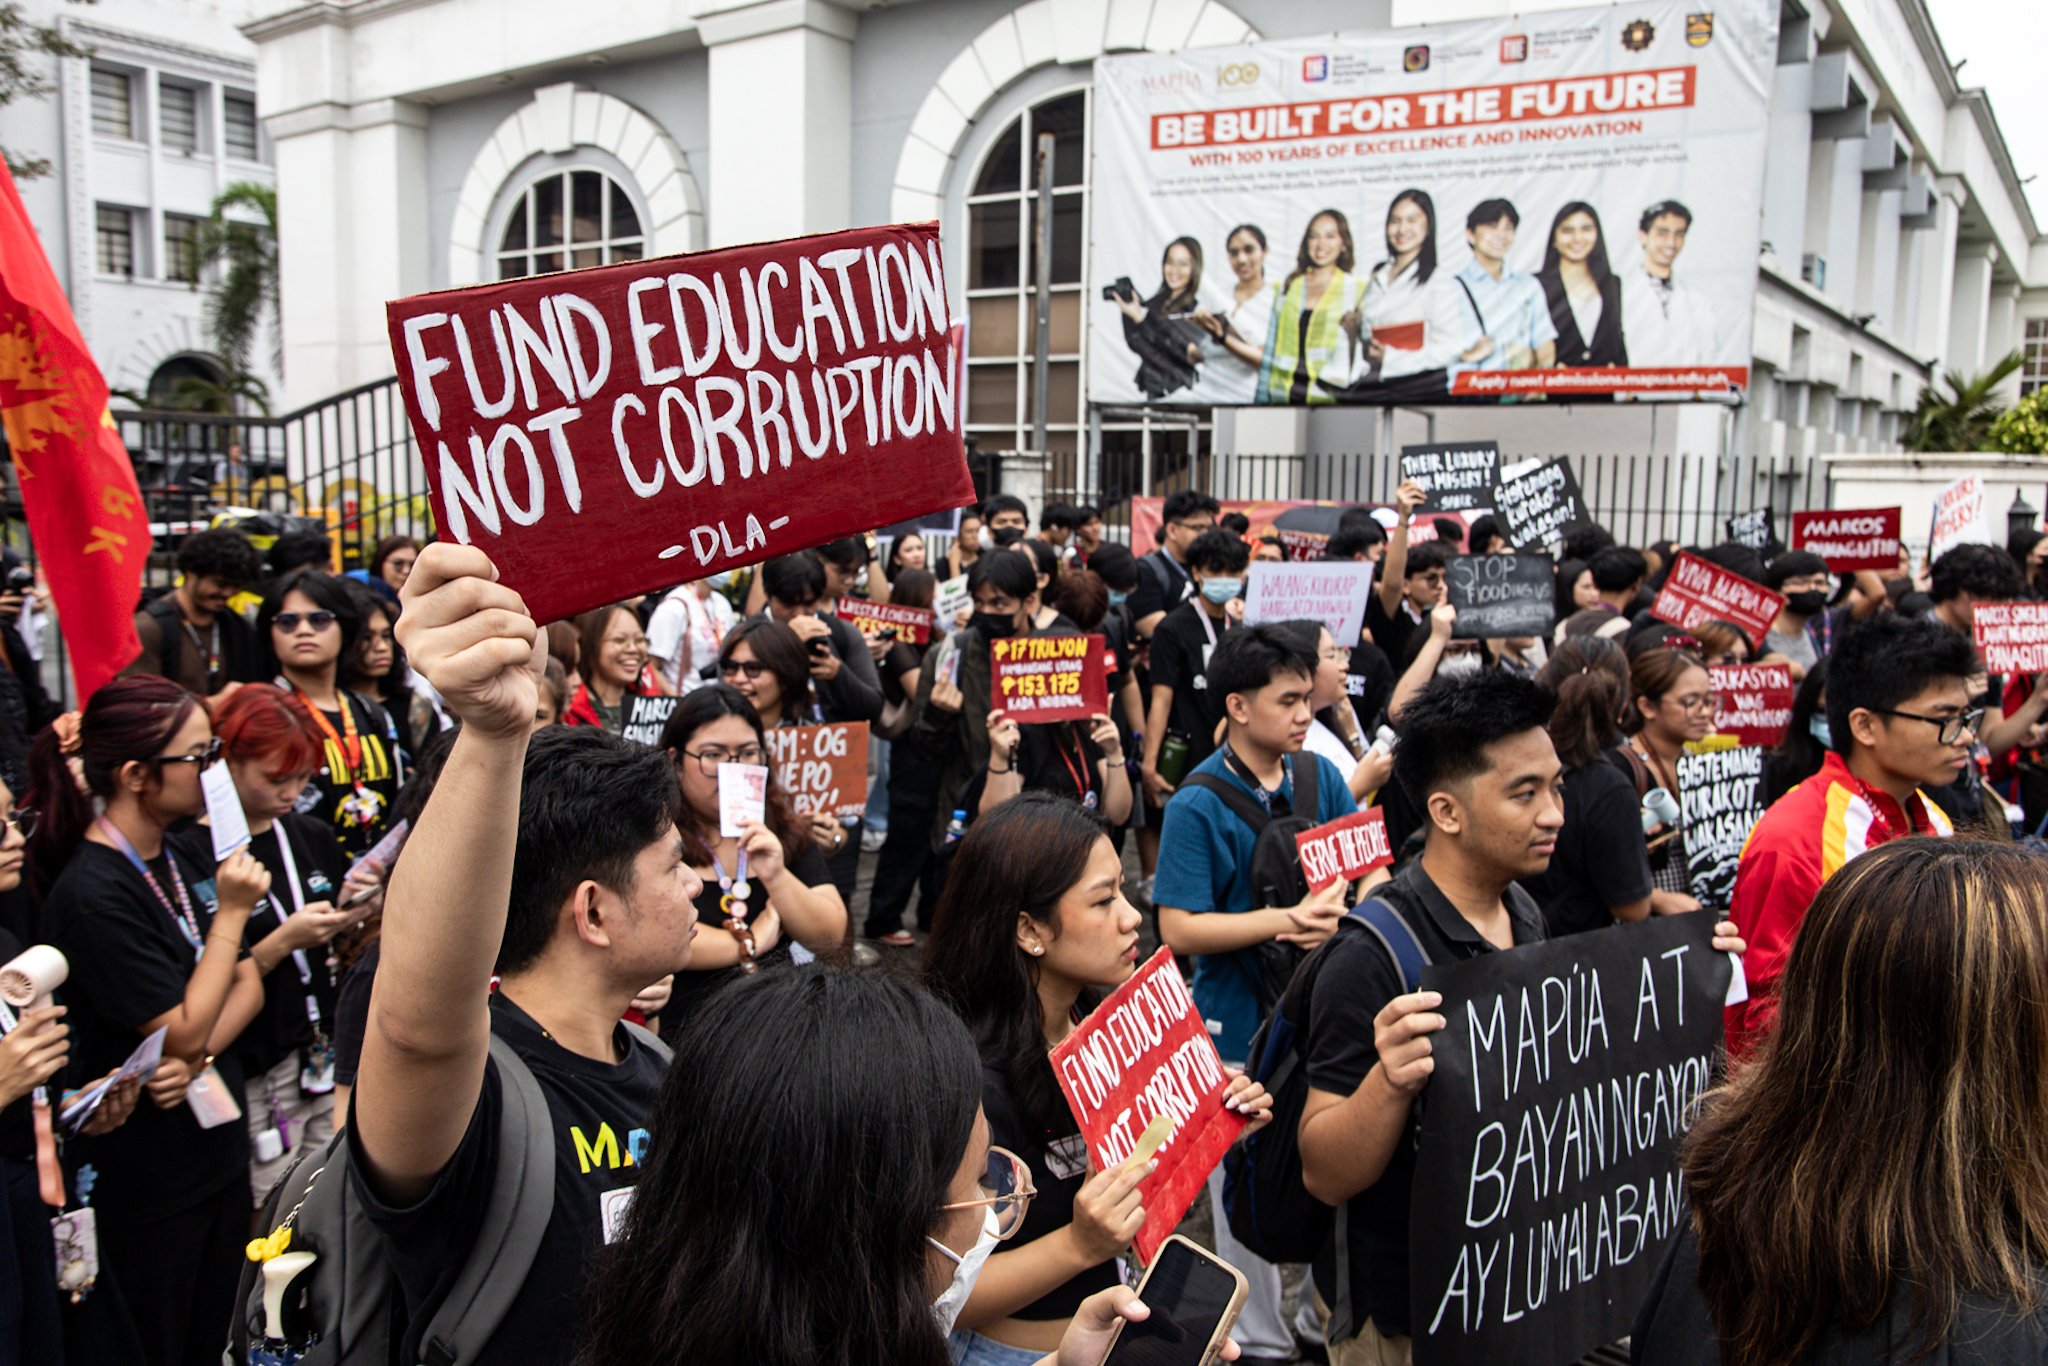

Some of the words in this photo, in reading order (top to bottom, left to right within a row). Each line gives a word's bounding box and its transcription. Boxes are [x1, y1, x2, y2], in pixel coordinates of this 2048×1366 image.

[1157, 114, 1206, 147] BE
[1213, 104, 1321, 143] BUILT
[1328, 97, 1411, 134] FOR
[1418, 88, 1501, 126] THE
[1510, 70, 1686, 119] FUTURE
[1189, 149, 1232, 167] WITH
[1237, 150, 1263, 165] 100
[1268, 147, 1322, 162] YEARS
[1326, 143, 1348, 158] OF
[1355, 133, 1467, 157] EXCELLENCE
[1472, 129, 1515, 148] AND
[1518, 120, 1643, 141] INNOVATION
[403, 293, 612, 431] FUND
[628, 239, 947, 386] EDUCATION
[437, 406, 582, 545] NOT
[612, 343, 955, 498] CORRUPTION
[1401, 453, 1443, 476] THEIR
[1444, 450, 1496, 473] LUXURY
[1802, 516, 1887, 537] MARCOS
[1453, 555, 1518, 590] STOP
[1028, 637, 1089, 660] TRILYON
[1708, 666, 1790, 691] EDUKASYON
[813, 727, 848, 757] OG
[1676, 745, 1763, 790] SISTEMANG
[1301, 834, 1343, 884] SERVE
[1336, 828, 1361, 871] THE
[1353, 820, 1392, 866] PEOPLE
[1061, 1028, 1121, 1125] FUND
[1106, 959, 1192, 1070] EDUCATION
[1466, 962, 1609, 1112] MAPÚA
[1465, 1083, 1605, 1229] BAYAN
[1429, 1238, 1500, 1335] AY
[1503, 1168, 1684, 1323] LUMALABAN
